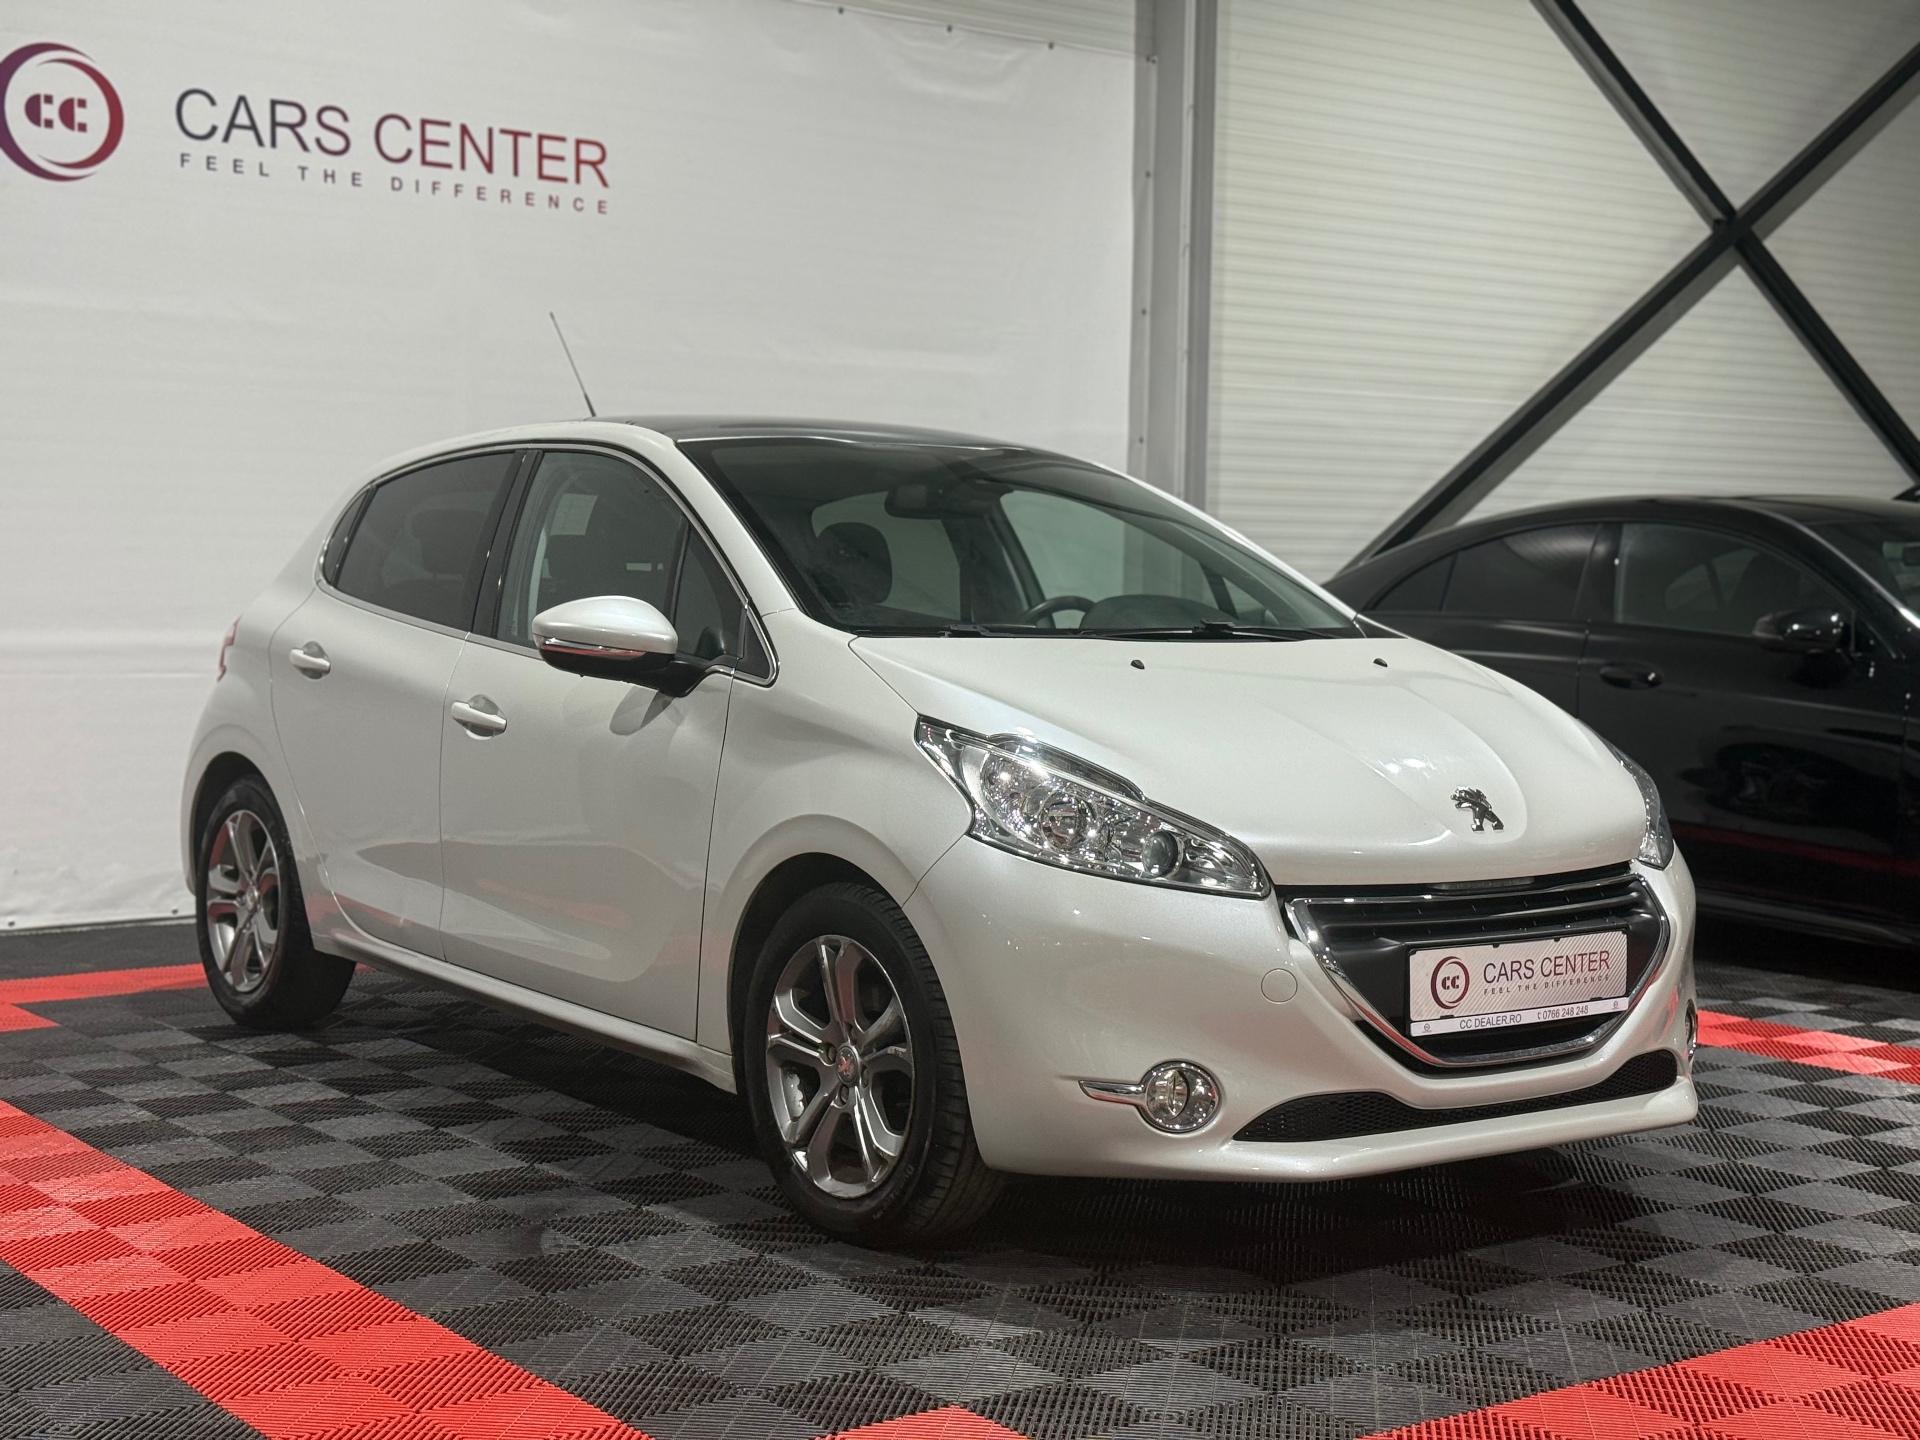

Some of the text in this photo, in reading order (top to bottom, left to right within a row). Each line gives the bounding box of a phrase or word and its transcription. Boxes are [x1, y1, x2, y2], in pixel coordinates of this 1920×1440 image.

[175, 88, 609, 188] CARS CENTER
[180, 152, 607, 214] FEEL THE DIFFERENCE
[1483, 950, 1610, 983] CARS CENTER
[1459, 1013, 1522, 1030] CC DEALER.RO
[1542, 1005, 1589, 1020] 0766 248 248
